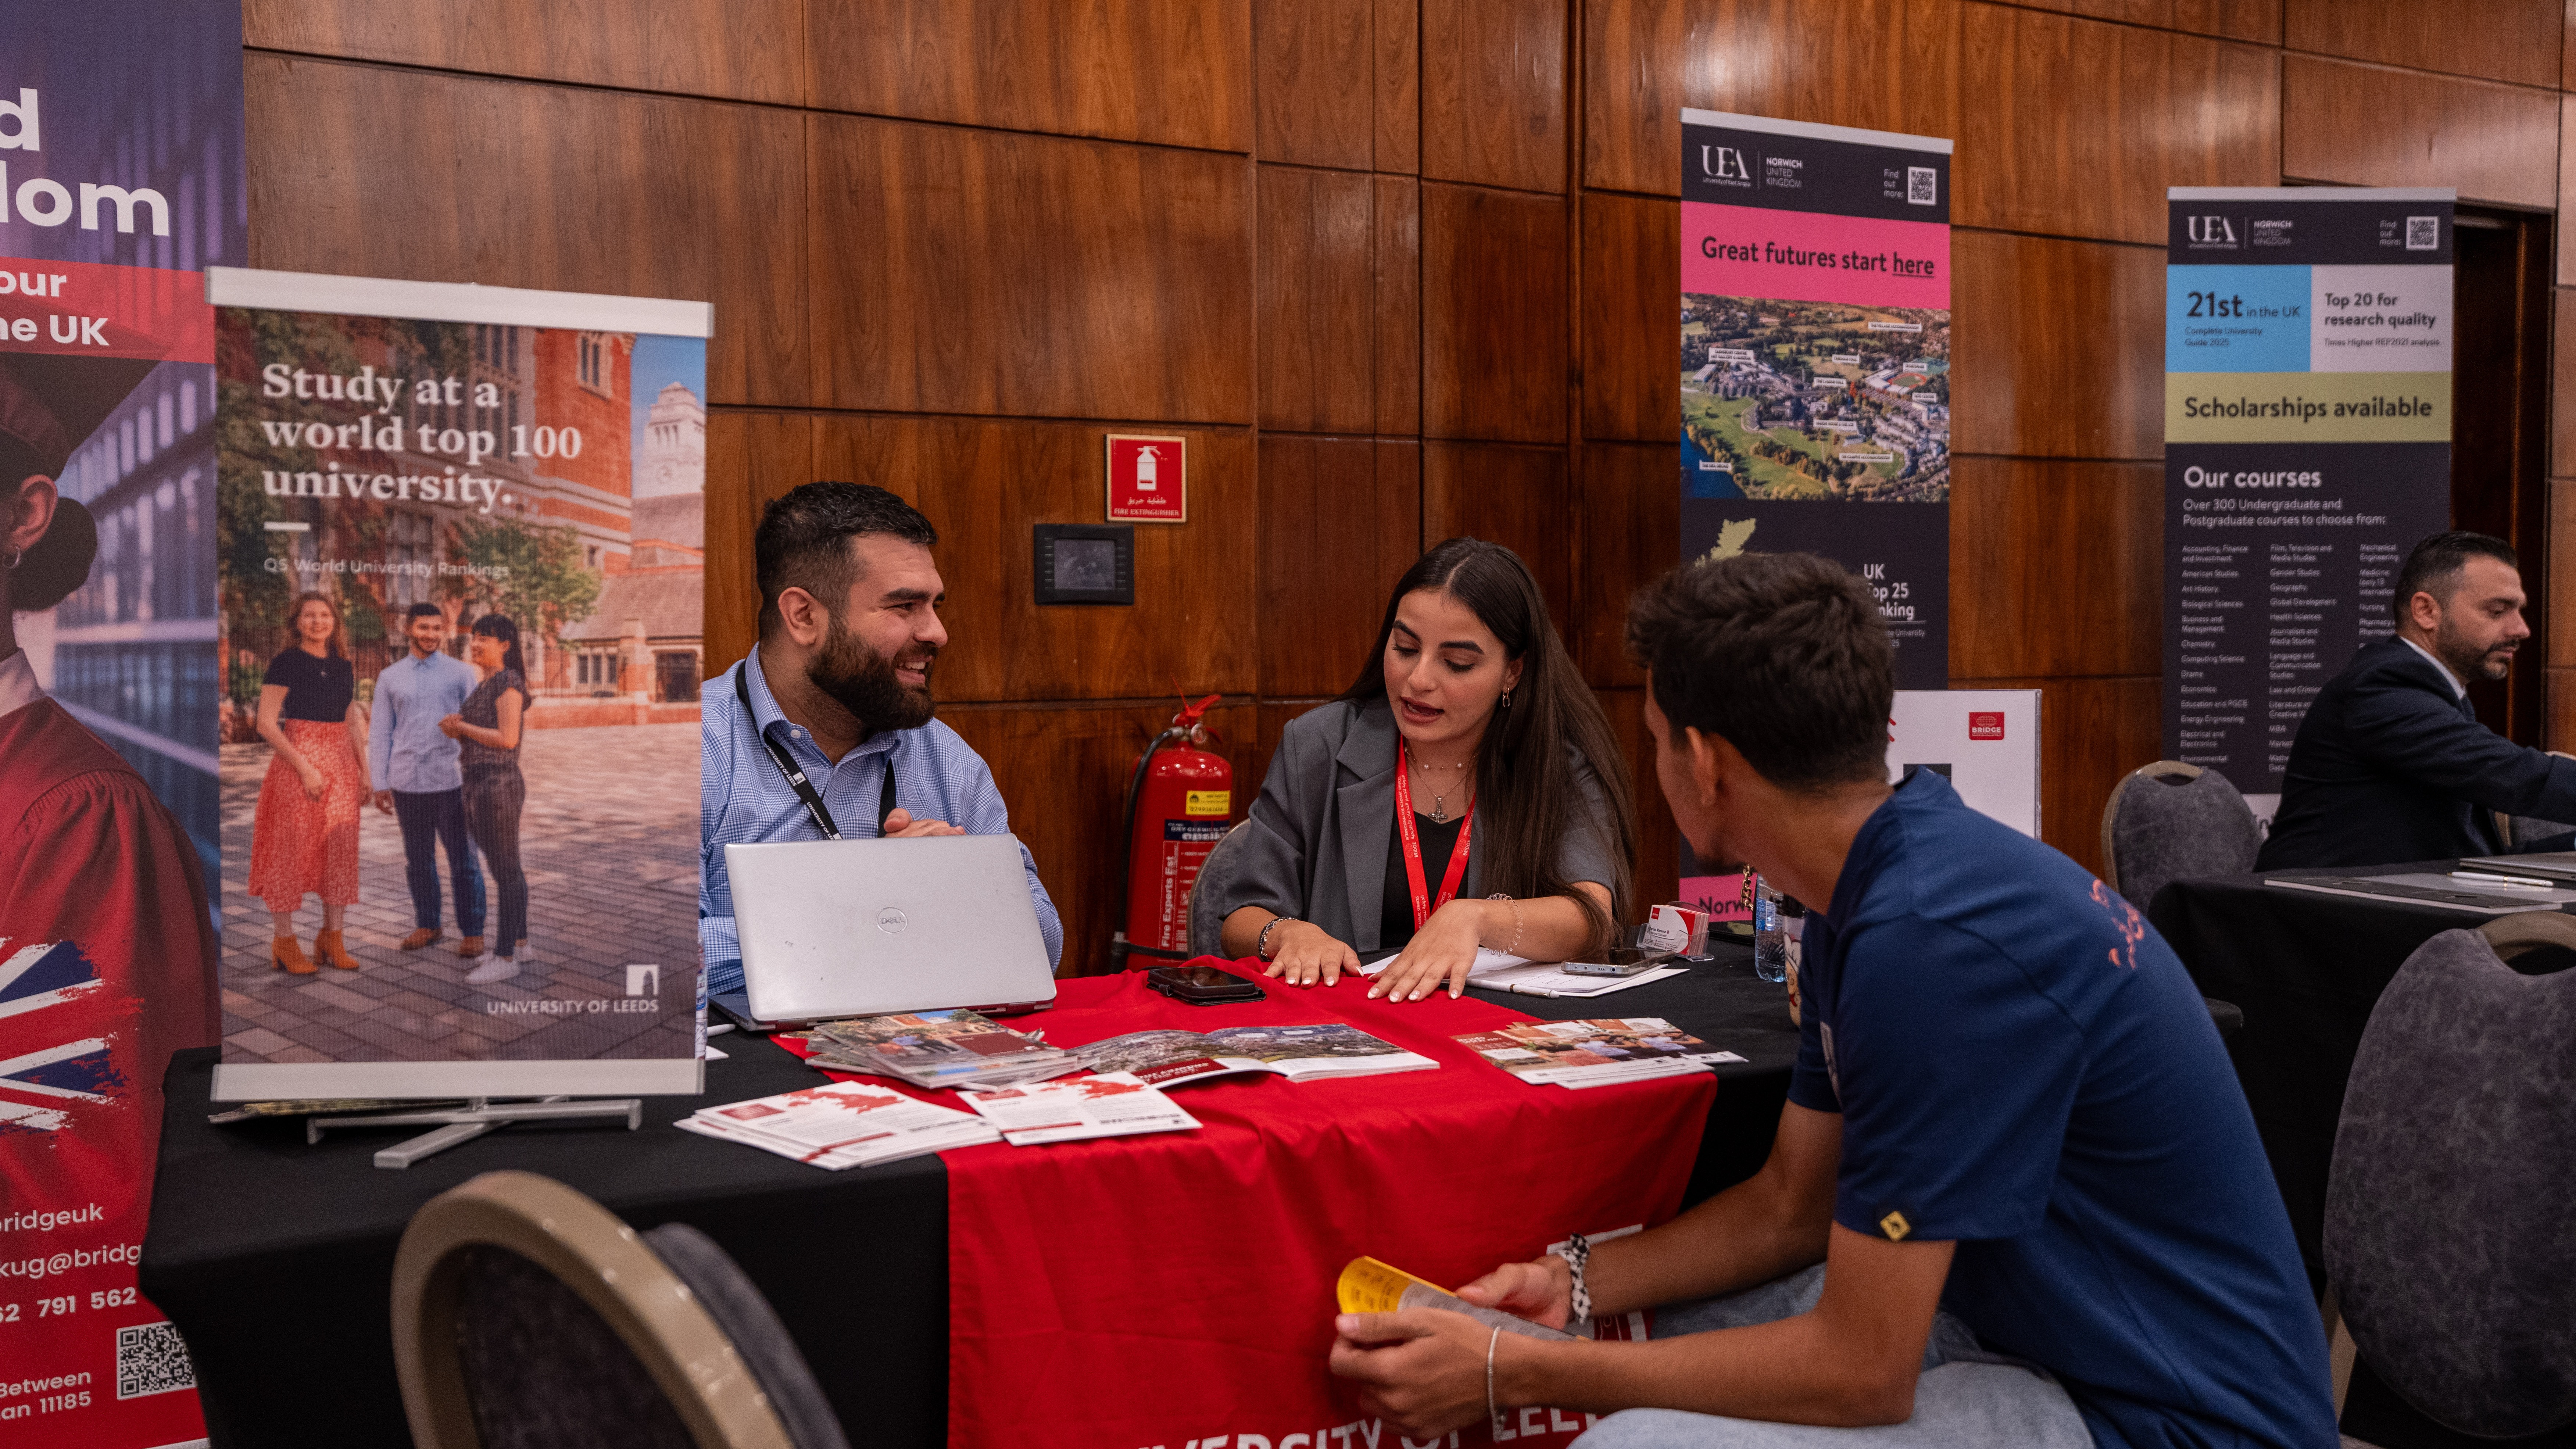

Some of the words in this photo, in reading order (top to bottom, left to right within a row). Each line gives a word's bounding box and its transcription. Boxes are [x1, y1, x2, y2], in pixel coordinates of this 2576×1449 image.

[1701, 145, 1750, 180] UEA
[1766, 157, 1803, 168] NORWICH
[1766, 167, 1793, 177] UNITED
[1766, 177, 1801, 188] KINGDOM
[1884, 168, 1899, 179] Find
[1884, 180, 1896, 189] out
[1884, 189, 1903, 198] more:
[2188, 216, 2237, 243] UEA
[2254, 220, 2293, 229] NORWICH
[2380, 221, 2397, 229] Find
[1702, 236, 1758, 262] Great
[1765, 241, 1836, 268] futures
[1842, 251, 1887, 272] start
[1893, 252, 1935, 275] here
[2186, 291, 2243, 318] 21st
[2246, 306, 2257, 317] in
[2259, 306, 2280, 318] the
[2282, 305, 2300, 318] UK
[2325, 293, 2350, 308] Top
[2353, 293, 2372, 306] 20
[2377, 293, 2398, 306] for
[49, 314, 110, 346] UK
[2325, 313, 2384, 326] research
[2387, 313, 2436, 329] quality
[2185, 327, 2223, 337] Complete
[2225, 327, 2262, 336] University
[2185, 338, 2207, 347] Guide
[2210, 338, 2229, 347] 2025
[2325, 338, 2346, 347] Times
[2347, 338, 2373, 348] Higher
[2375, 338, 2409, 347] REF2021
[2411, 339, 2439, 348] analysis
[262, 364, 404, 414] Study
[416, 375, 462, 405] at
[475, 382, 500, 408] a
[2185, 396, 2327, 422] Scholarships
[2334, 397, 2432, 418] available
[262, 415, 404, 452] world
[418, 423, 495, 465] top
[510, 425, 582, 458] 100
[2184, 465, 2229, 489] Our
[2234, 471, 2322, 489] courses
[262, 461, 512, 514] university.
[2183, 498, 2210, 511] Over
[2213, 498, 2235, 511] 300
[2239, 498, 2319, 512] Undergraduate
[2323, 498, 2342, 510] and
[2183, 514, 2253, 529] Postgraduate
[2257, 515, 2300, 526] courses
[2302, 515, 2314, 526] to
[2315, 514, 2353, 526] choose
[2356, 514, 2387, 525] from:
[264, 557, 287, 573] QS
[294, 558, 346, 574] World
[350, 559, 432, 578] University
[439, 562, 510, 580] Rankings
[1864, 564, 1885, 580] UK
[1892, 582, 1909, 599] 25
[1879, 601, 1915, 620] nking
[1895, 629, 1926, 638] University
[766, 745, 784, 769] UNIVERSITY
[786, 773, 797, 787] LEEDS
[806, 802, 824, 827] UNIVERSITY
[1163, 877, 1173, 922] Experts
[1162, 924, 1171, 947] Fire
[487, 1000, 584, 1014] UNIVERSITY
[588, 999, 608, 1013] OF
[613, 999, 659, 1013] LEEDS
[0, 1203, 103, 1232] ridgeuk
[37, 1295, 76, 1317] 791
[91, 1287, 137, 1310] 562
[0, 1372, 91, 1398] Between
[40, 1391, 91, 1414] 11185
